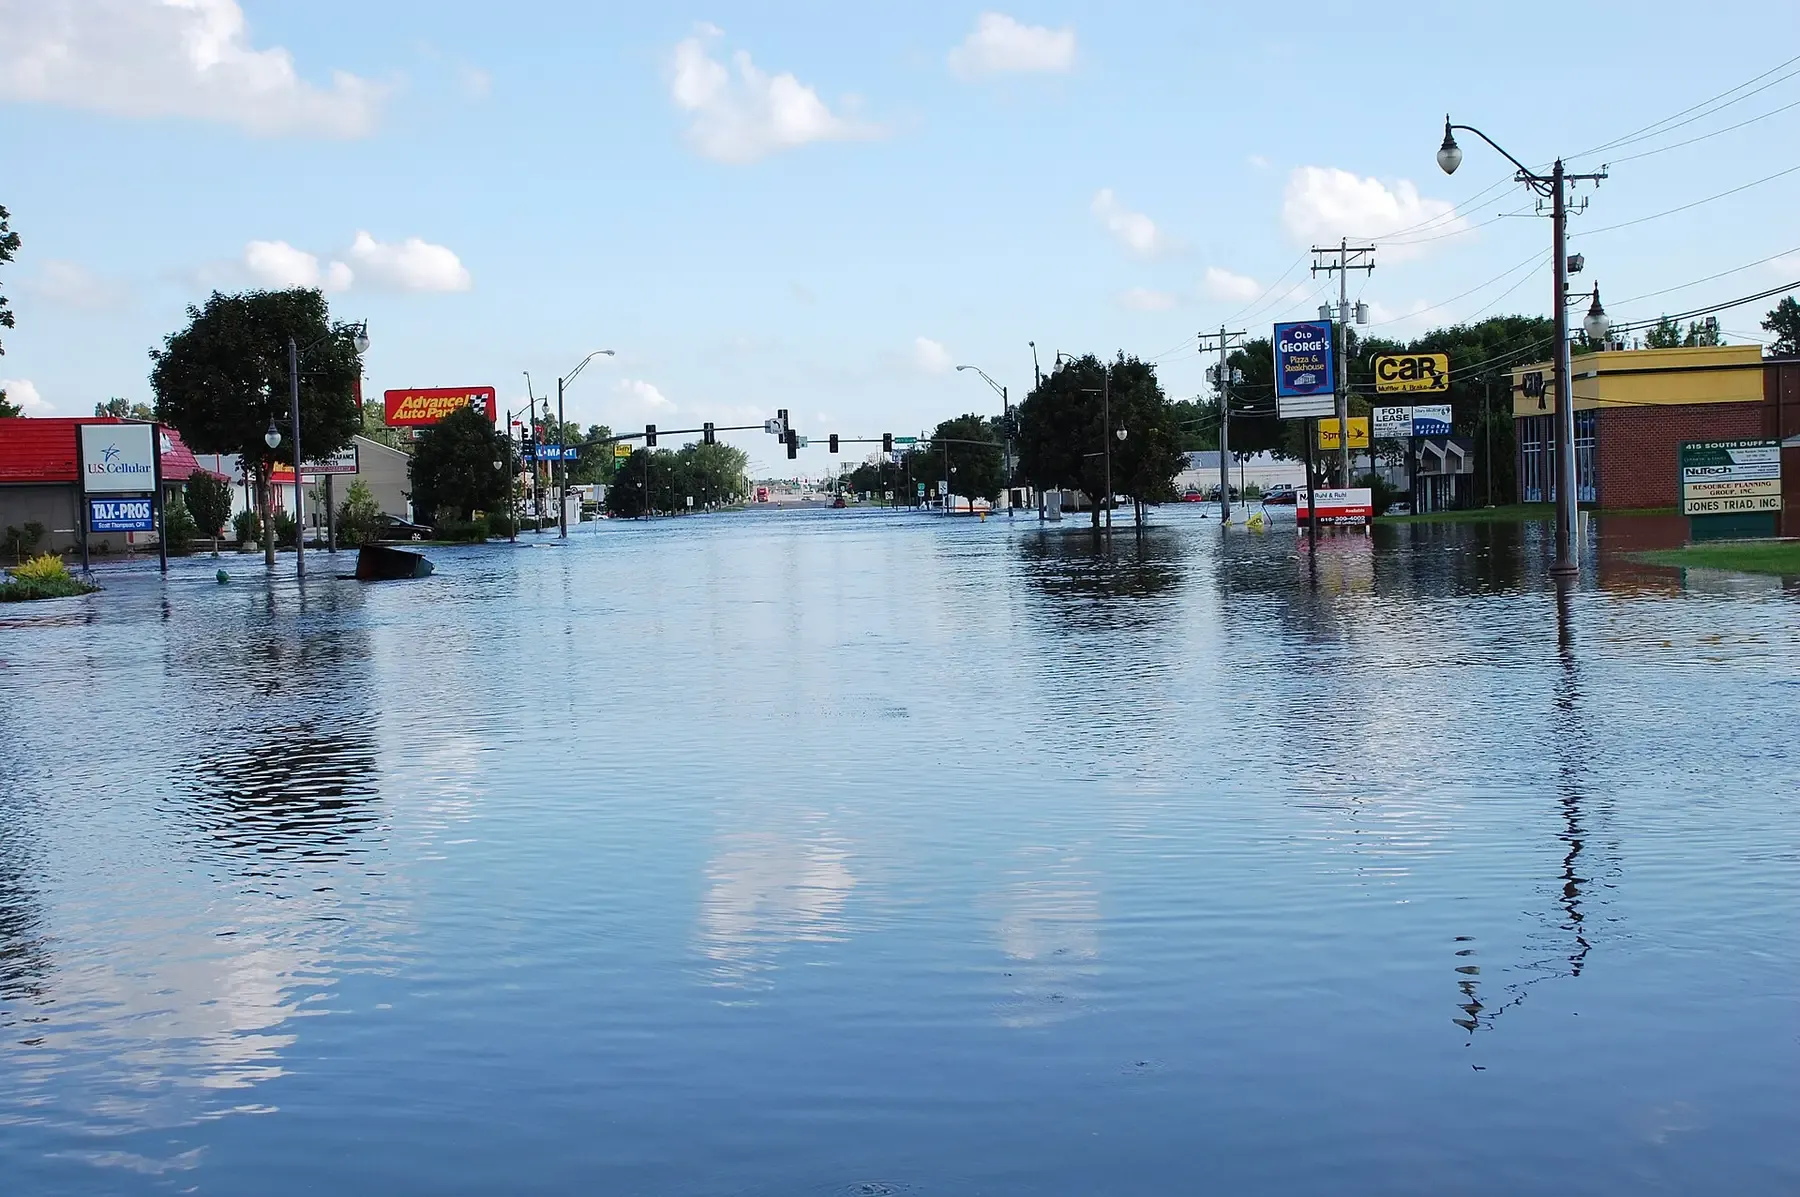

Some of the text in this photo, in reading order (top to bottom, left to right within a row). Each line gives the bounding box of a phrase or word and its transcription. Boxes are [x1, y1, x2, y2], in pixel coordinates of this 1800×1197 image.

[1294, 331, 1312, 340] OLD
[1279, 338, 1330, 353] GEORGE'S
[1290, 356, 1309, 364] Pizza
[1285, 364, 1325, 372] Steakhouse
[392, 408, 426, 420] Auto
[1376, 414, 1410, 422] LEASE
[106, 463, 151, 473] Cellular
[1687, 498, 1779, 511] JONES TRIAD, INC.
[93, 503, 150, 519] TAX-PROS
